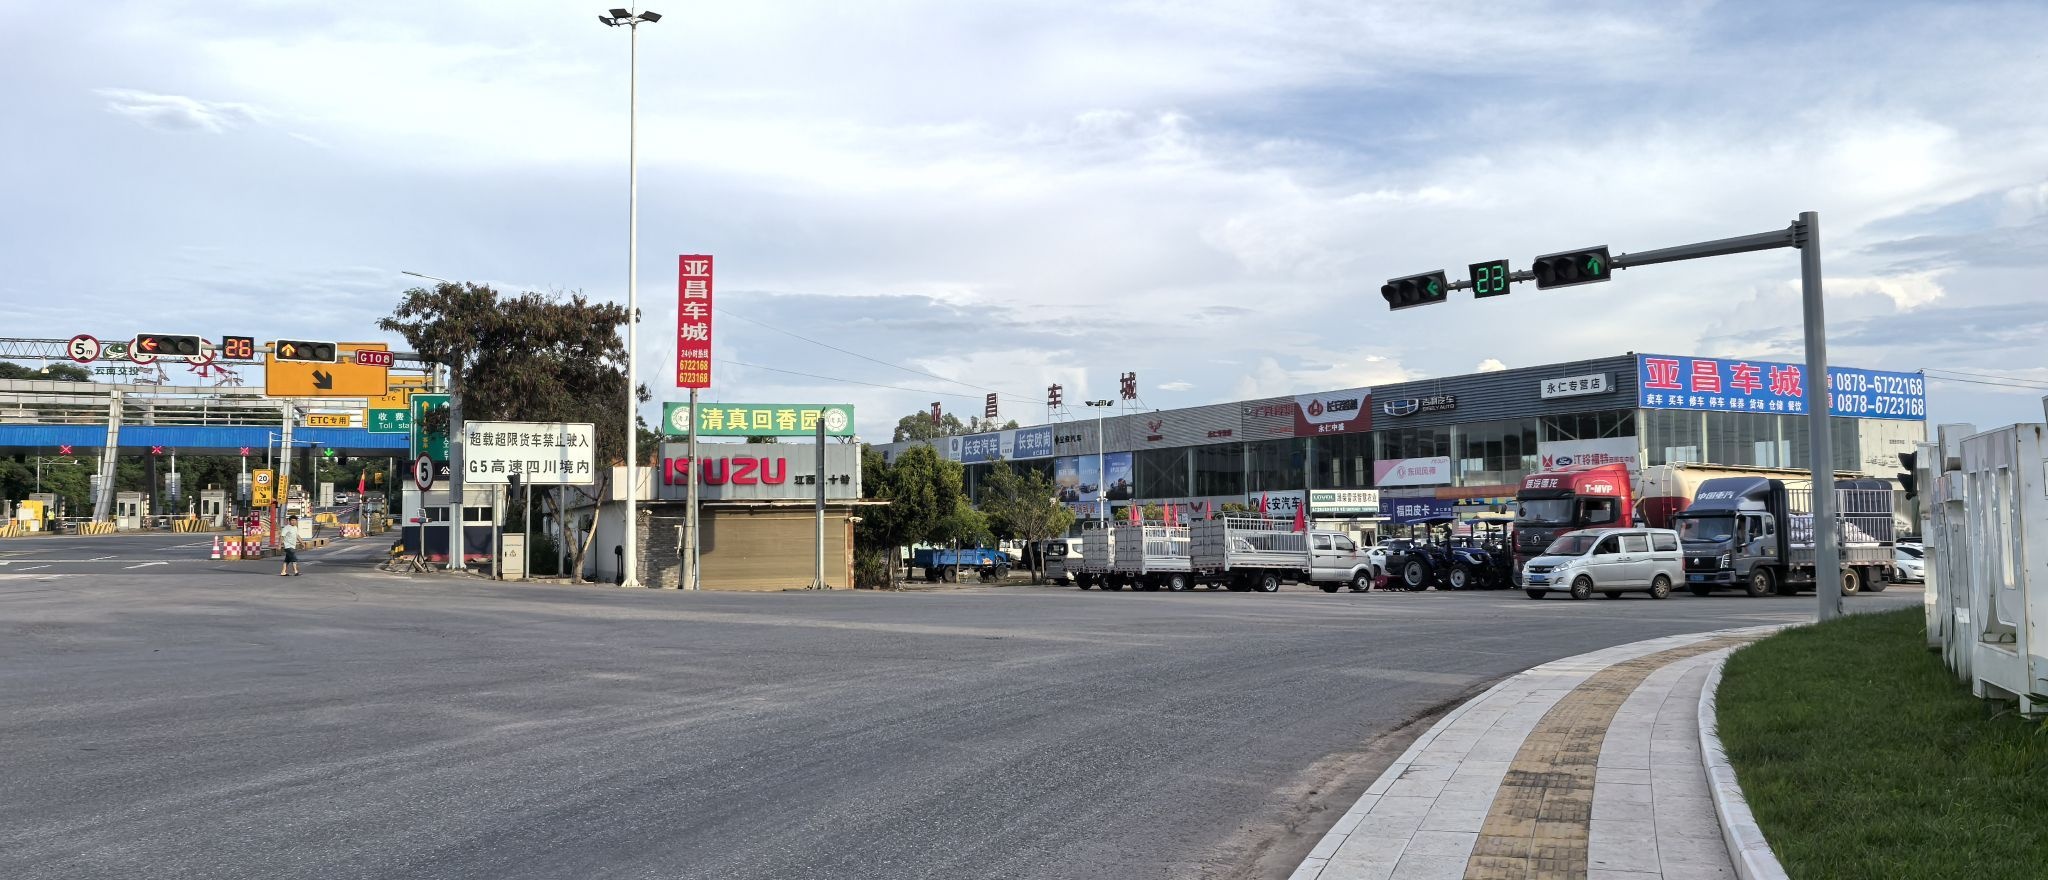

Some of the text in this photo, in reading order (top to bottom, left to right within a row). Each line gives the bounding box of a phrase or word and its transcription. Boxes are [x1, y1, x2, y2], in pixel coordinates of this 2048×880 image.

[1476, 265, 1504, 293] 23
[682, 260, 710, 341] 亚昌车城
[225, 339, 251, 357] 26
[681, 349, 708, 358] 24小时热线
[360, 354, 390, 364] G108
[680, 360, 708, 370] 6722168
[680, 373, 708, 382] 6723168
[1547, 378, 1601, 393] 永仁专营店
[1645, 358, 1802, 397] 亚昌车城
[1836, 372, 1923, 396] 0878-6722168
[1647, 393, 1802, 412] 卖车 买车 修车 停车 保养 货场 仓储 餐饮
[1837, 394, 1924, 416] 0878-6723168
[310, 416, 347, 425] ETC专用
[701, 408, 822, 430] 清真回香园
[470, 432, 589, 448] 超载超限货车禁止驶入
[965, 438, 998, 456] 长安汽车
[1018, 431, 1051, 449] 长安欧尚
[421, 462, 428, 481] 5
[469, 459, 589, 474] G5高速四川境内
[664, 457, 786, 486] ISUZU
[794, 474, 850, 485] 江西十铃
[1585, 484, 1613, 493] T-MVP
[1397, 504, 1430, 517] 福田皮卡
